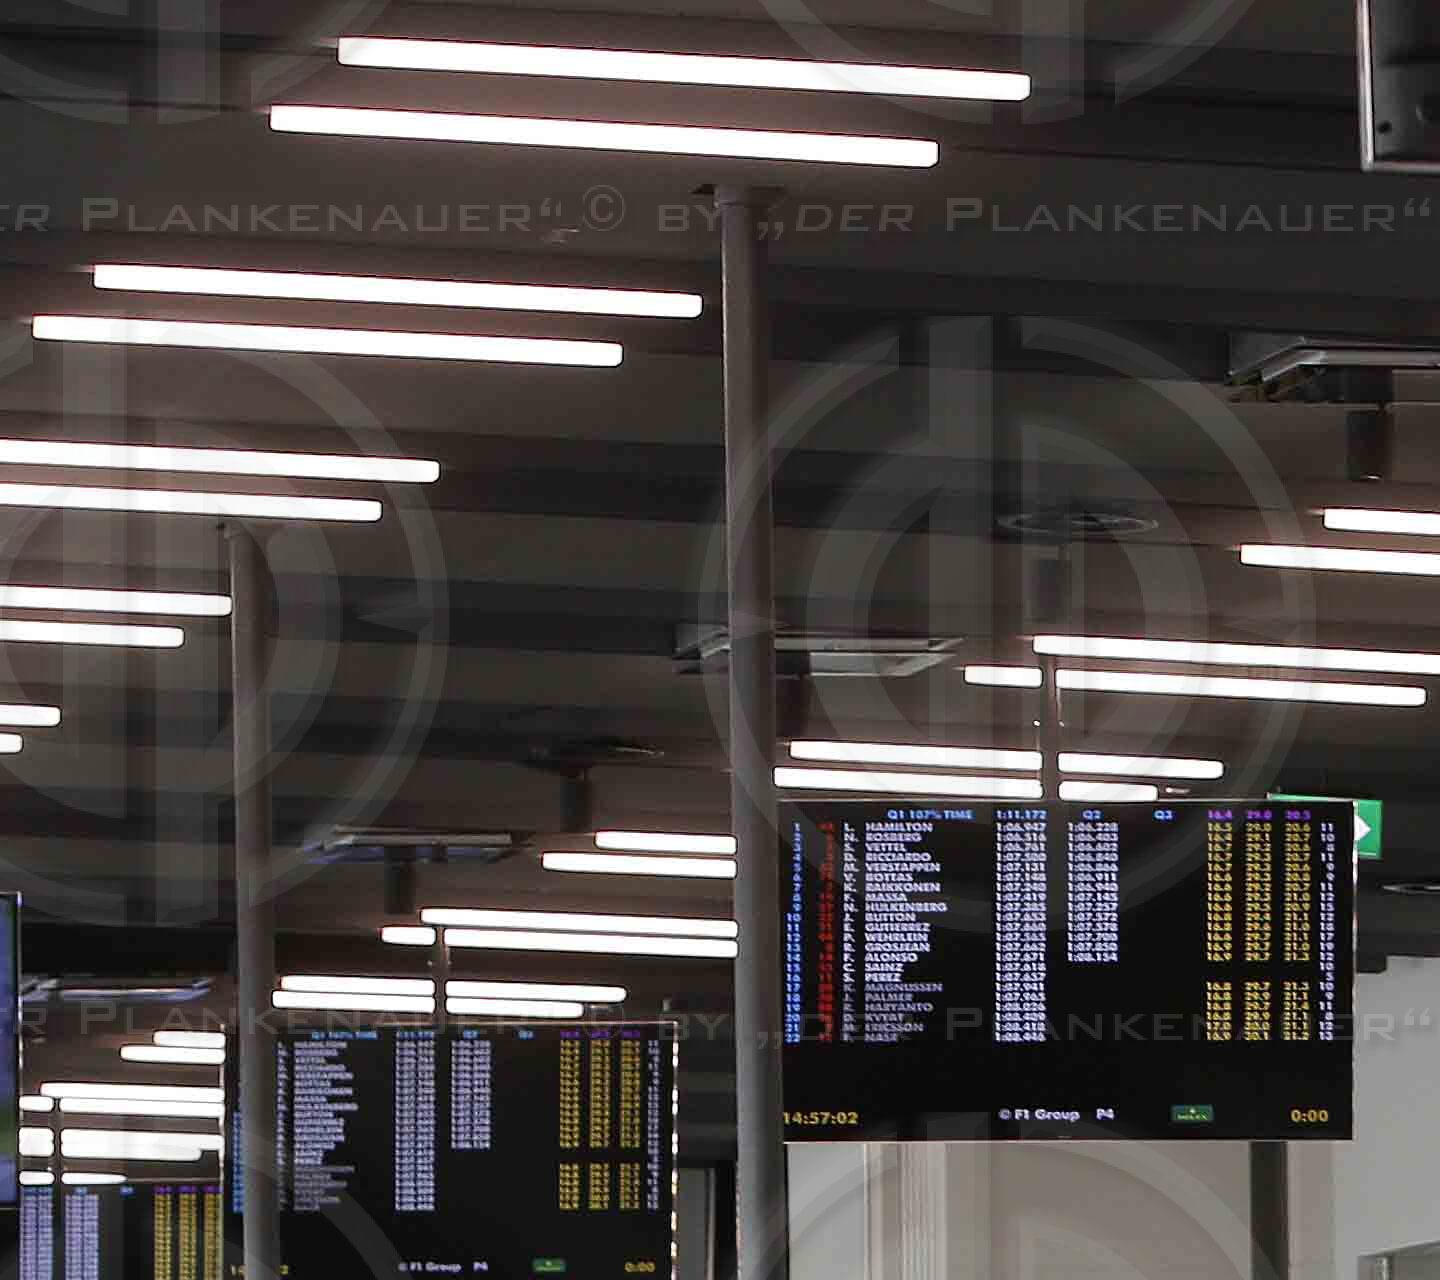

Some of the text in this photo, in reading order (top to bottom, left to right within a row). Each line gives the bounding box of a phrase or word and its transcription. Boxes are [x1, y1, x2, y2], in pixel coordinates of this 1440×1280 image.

[865, 822, 932, 832] HAMILTON
[864, 953, 918, 962] ALONSO
[864, 963, 904, 972] SAINZ
[783, 1111, 859, 1125] 14:57:02
[1035, 1108, 1080, 1122] Group
[1291, 1109, 1328, 1122] 0:00
